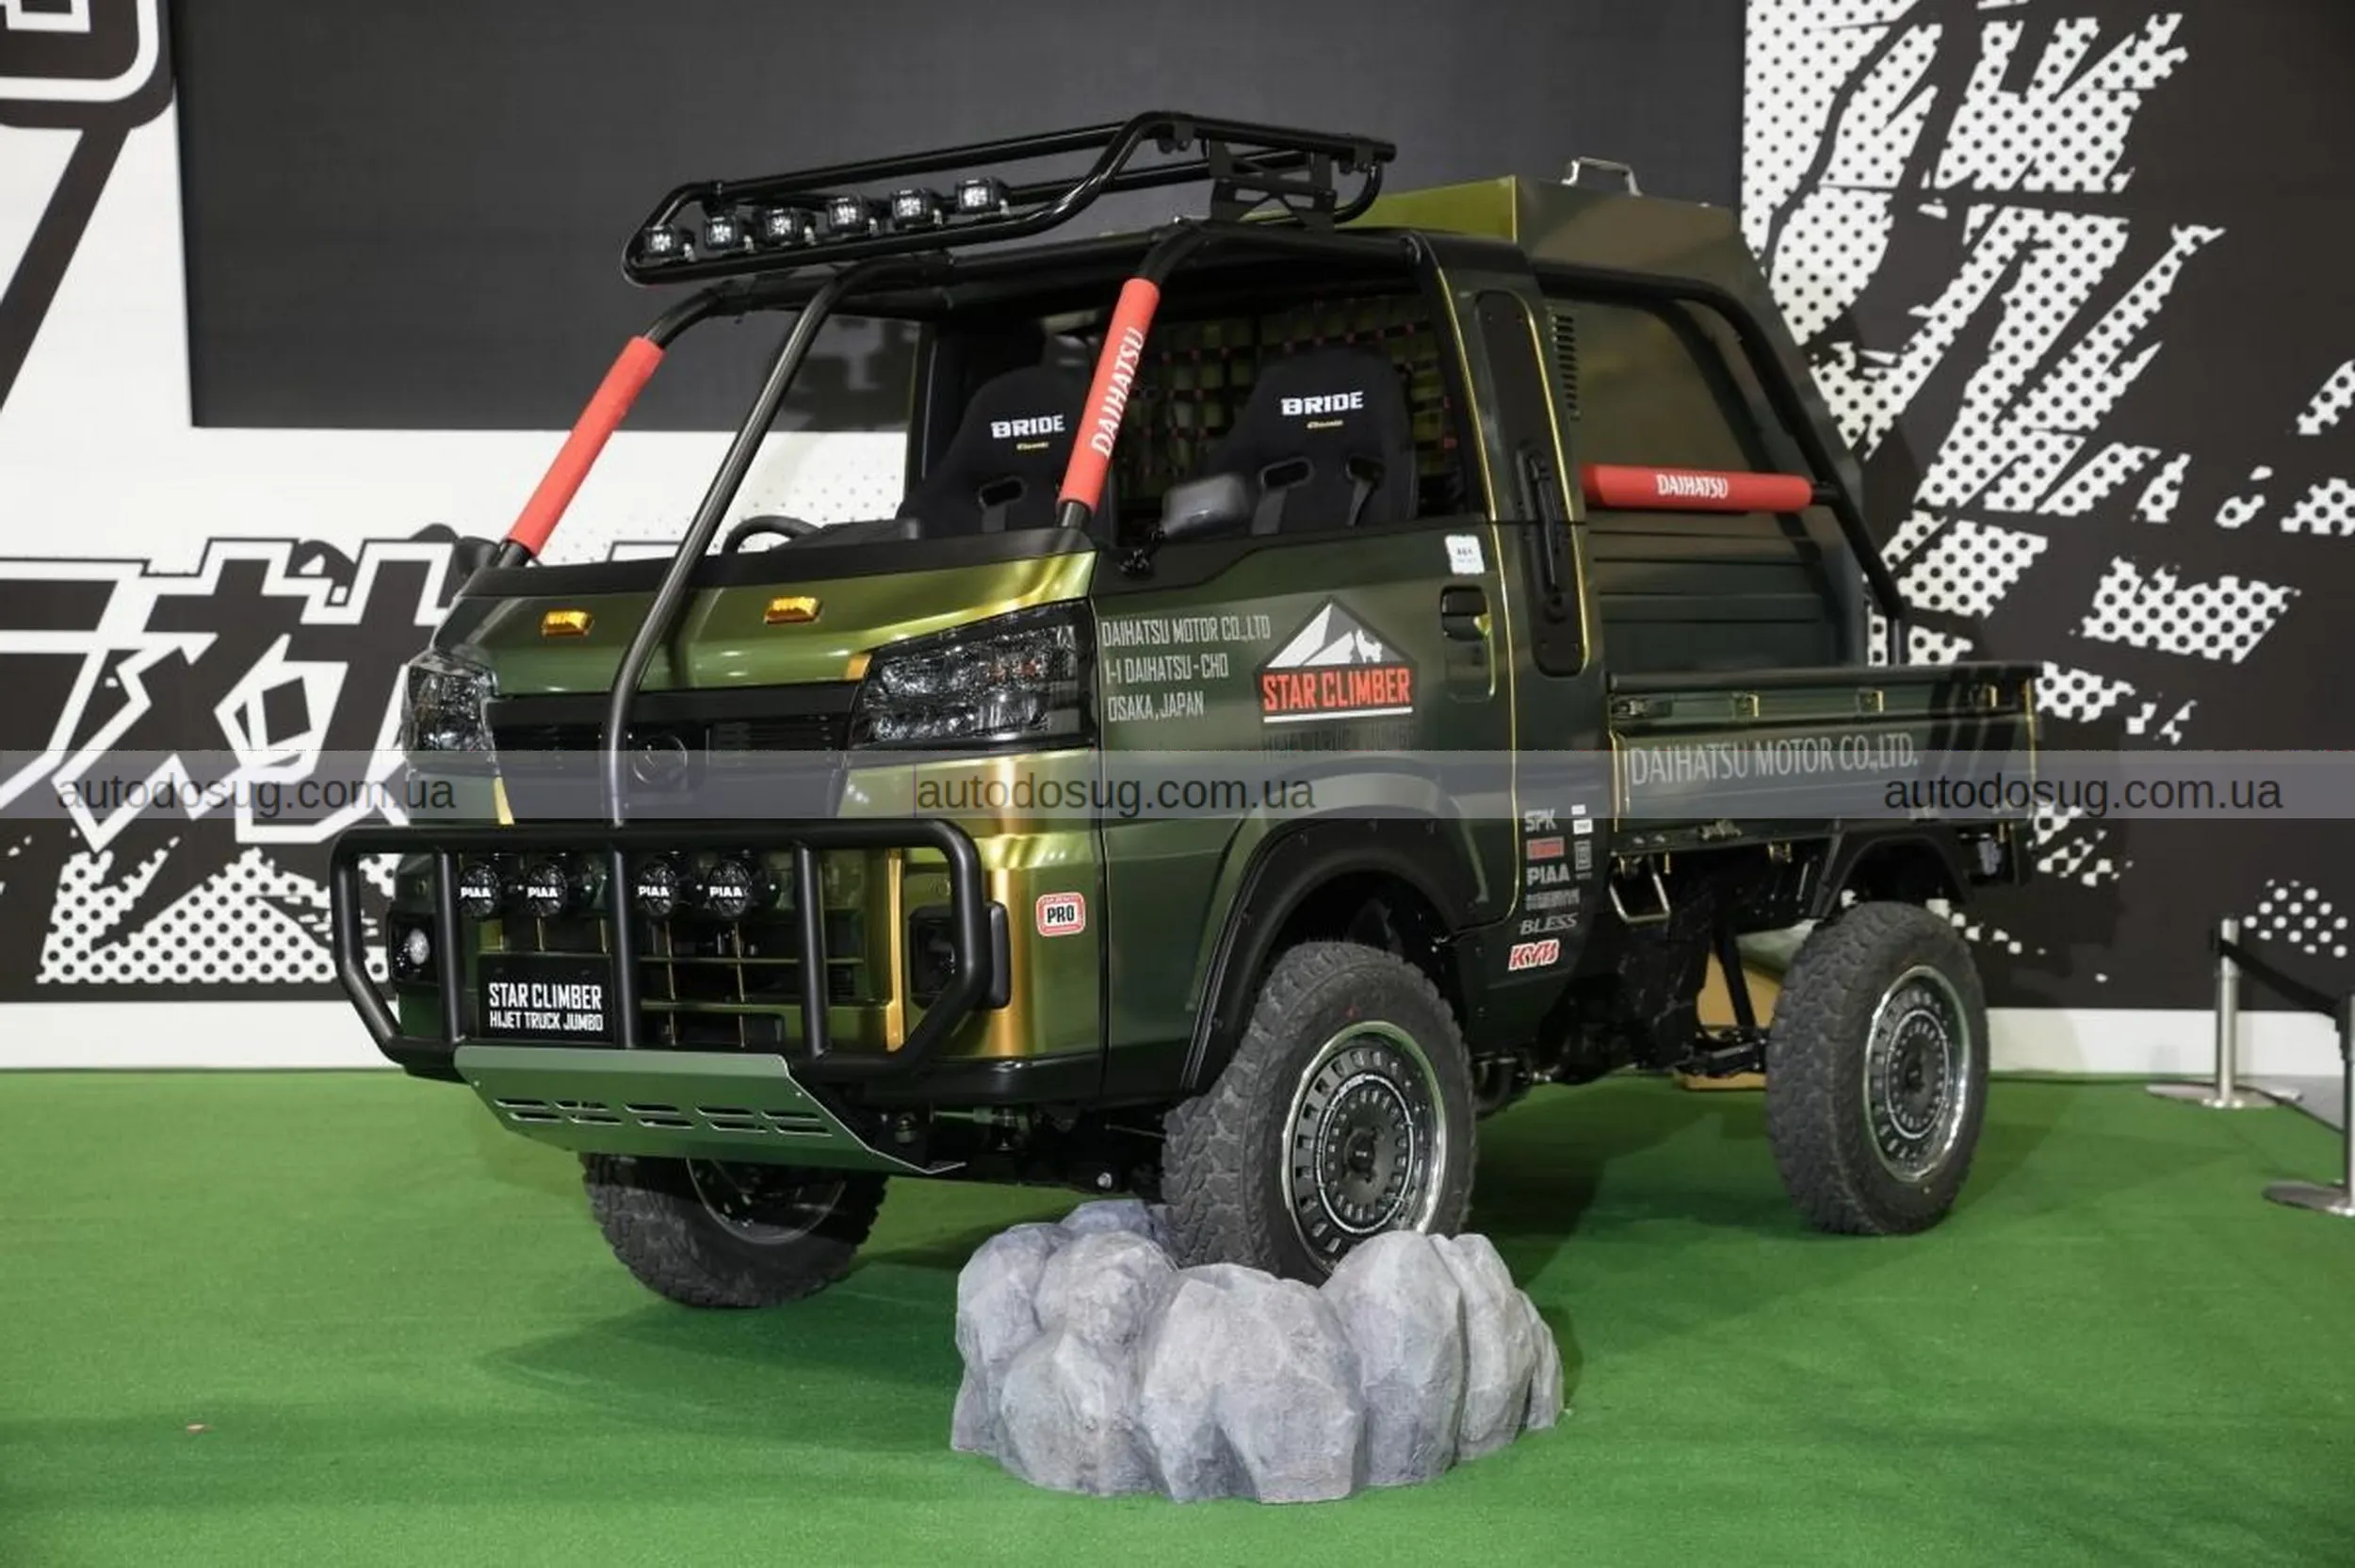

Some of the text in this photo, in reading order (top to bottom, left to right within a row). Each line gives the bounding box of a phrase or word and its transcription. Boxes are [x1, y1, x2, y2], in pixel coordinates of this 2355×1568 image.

[1091, 327, 1146, 458] DAIHATSU
[1279, 392, 1364, 416] BRIDE
[991, 415, 1065, 439] BRIDE
[1656, 474, 1729, 499] DAIHATSU
[1101, 617, 1169, 647] DAIHATSU
[1172, 617, 1217, 643] MOTOR
[1262, 668, 1410, 711] STAR CLIMBER
[1632, 747, 1747, 786] DAIHATSU
[1755, 736, 1835, 778] MOTOR
[1526, 863, 1570, 886] PIAA
[461, 886, 491, 898] PIAA
[528, 886, 558, 897] PIAA
[639, 885, 669, 897] PIAA
[710, 885, 742, 897] PIAA
[1047, 904, 1075, 924] PRO
[1519, 913, 1579, 935] BLESS
[489, 982, 602, 1010] STAR CLIMBER
[489, 1011, 604, 1031] HIJET TRUCK JUMBO
